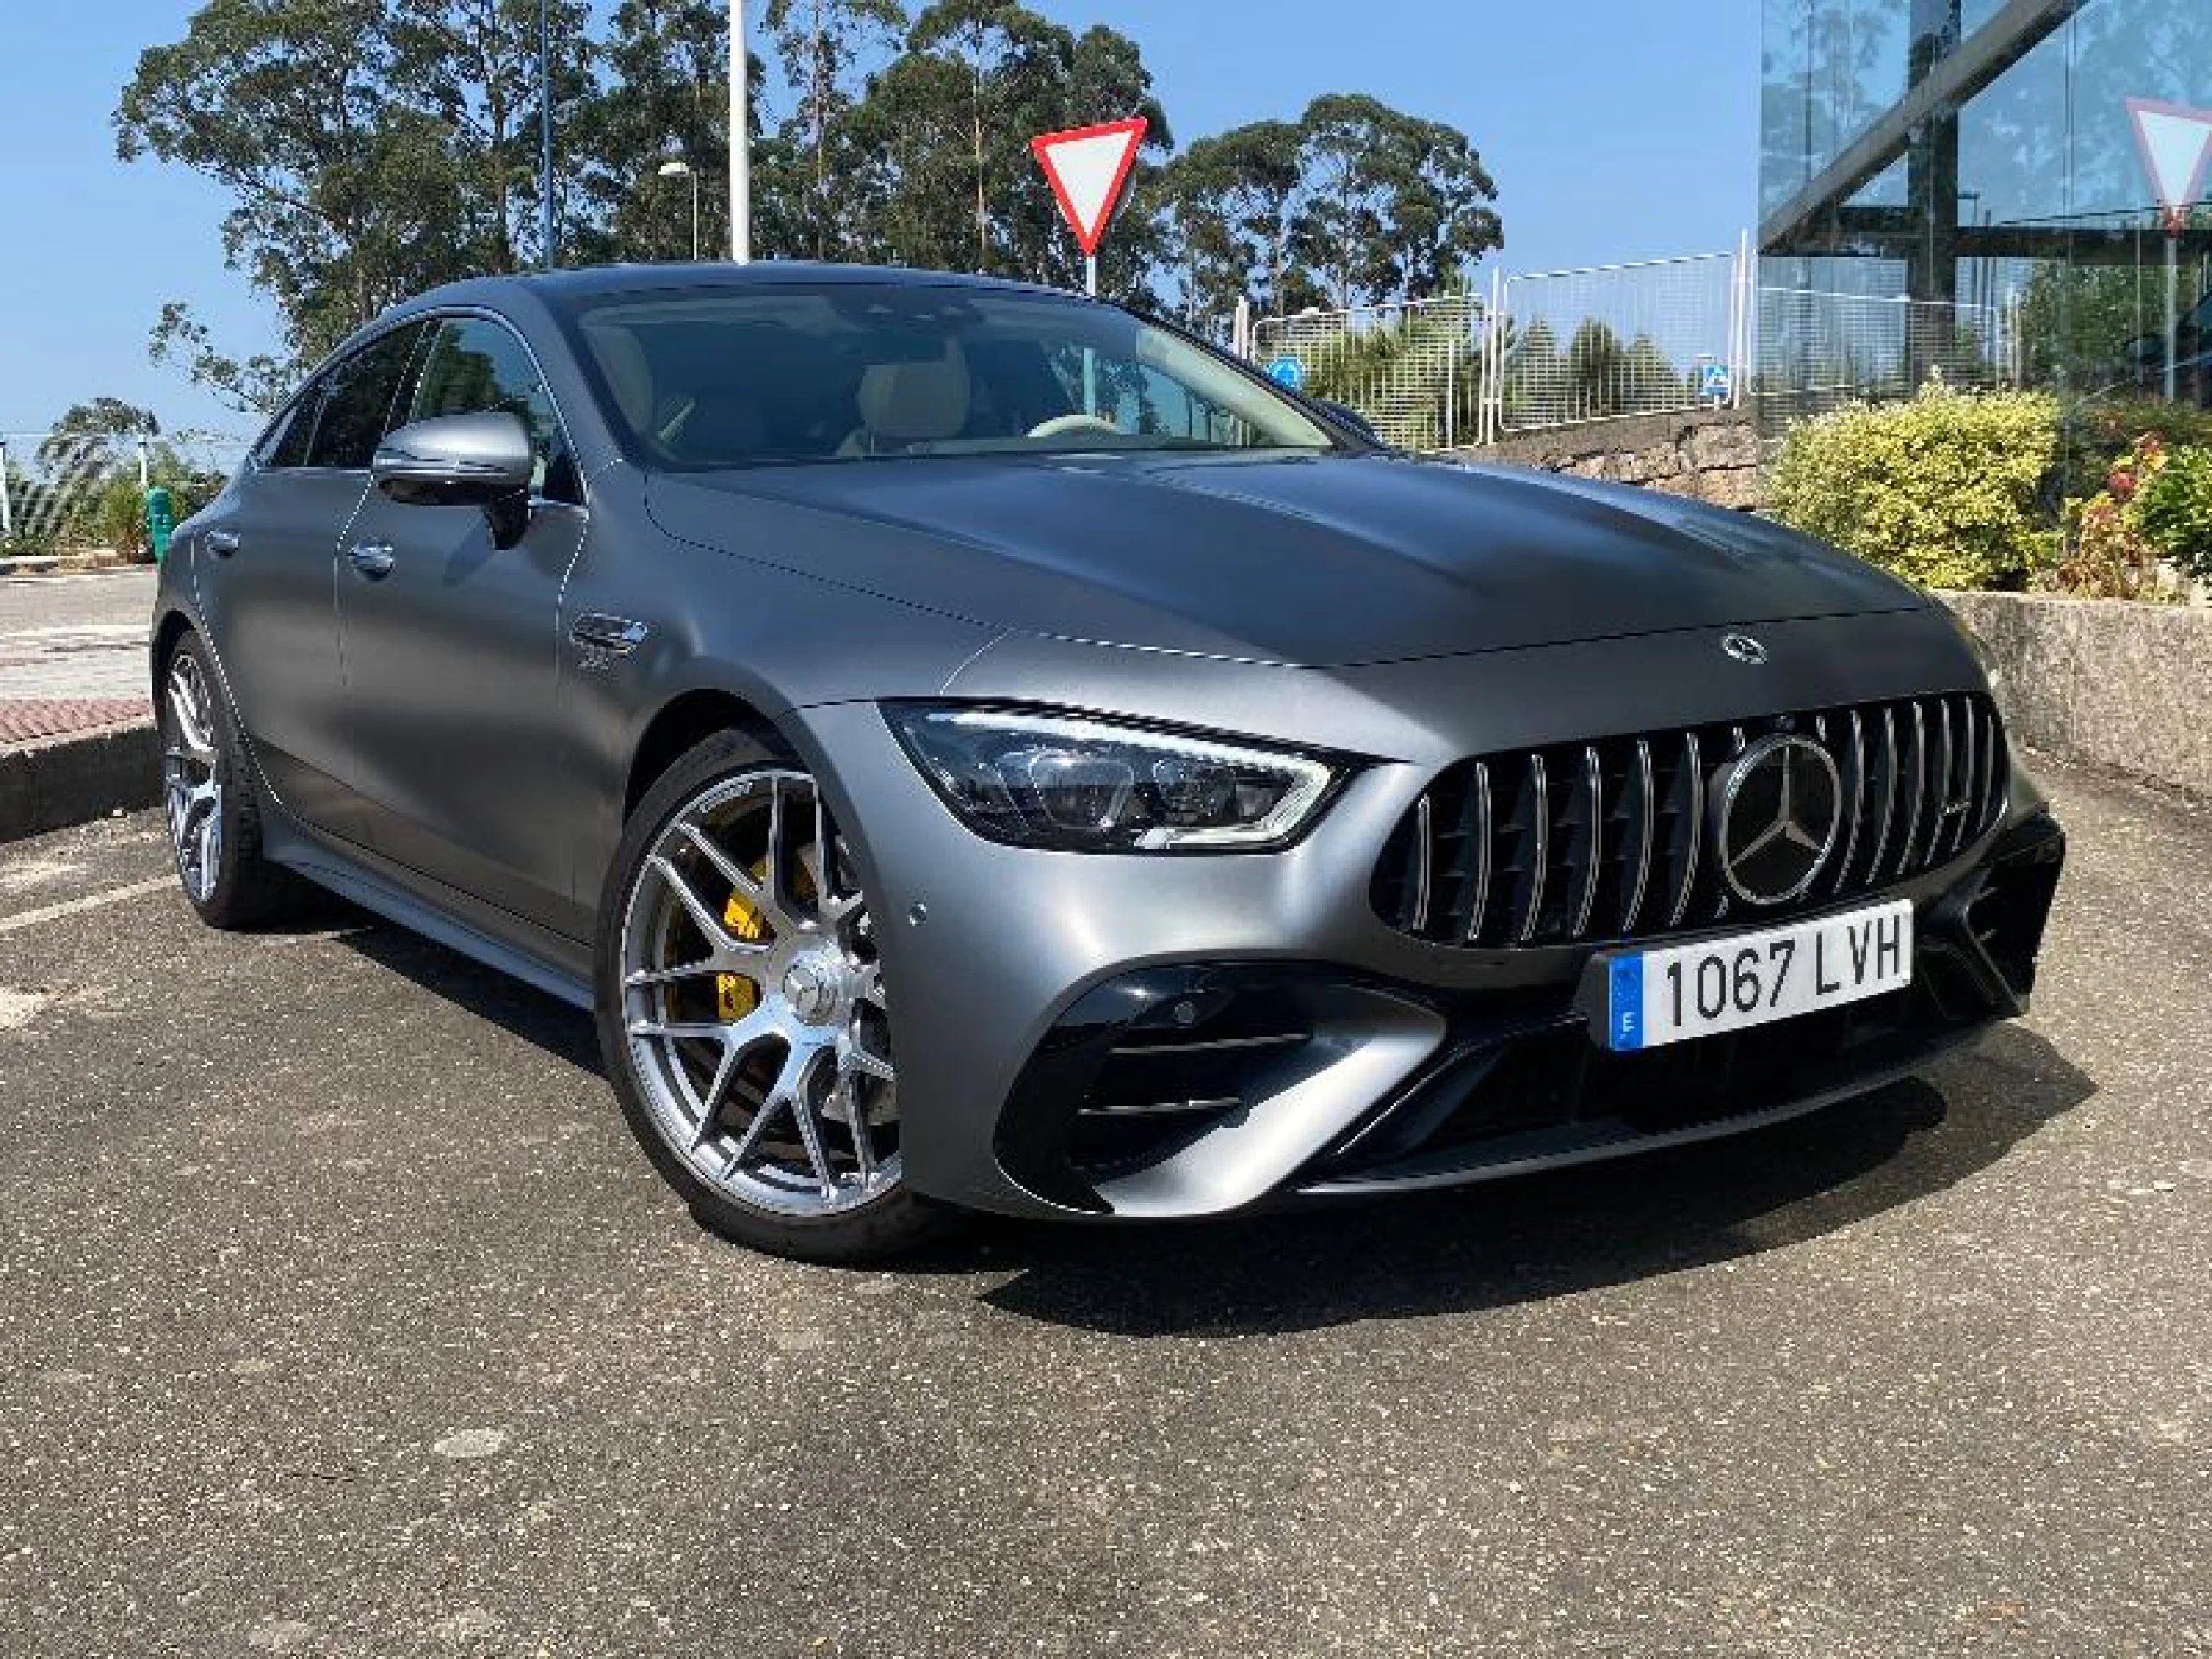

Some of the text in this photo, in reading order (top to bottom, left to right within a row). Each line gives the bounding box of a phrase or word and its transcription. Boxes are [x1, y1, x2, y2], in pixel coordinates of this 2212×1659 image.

[1621, 913, 1901, 1033] E 1067 LVH
